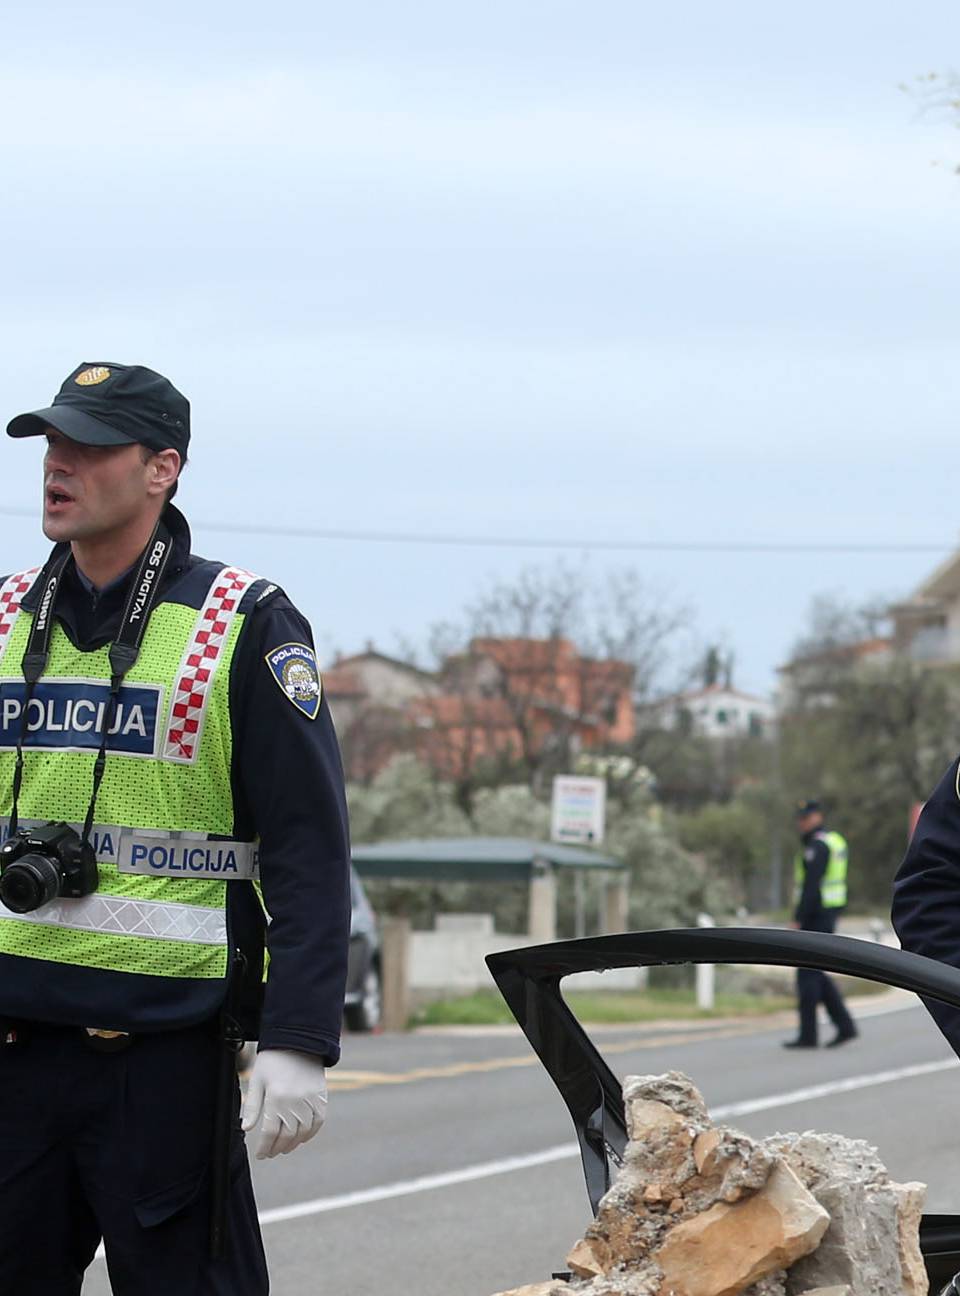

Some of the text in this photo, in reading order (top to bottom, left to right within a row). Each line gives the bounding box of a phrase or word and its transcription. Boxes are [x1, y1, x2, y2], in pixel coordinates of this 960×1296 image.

[36, 577, 57, 630] Canon
[129, 540, 166, 623] EOS DIGITAL
[2, 698, 147, 737] POLICIJA
[129, 843, 238, 873] POLICIJA
